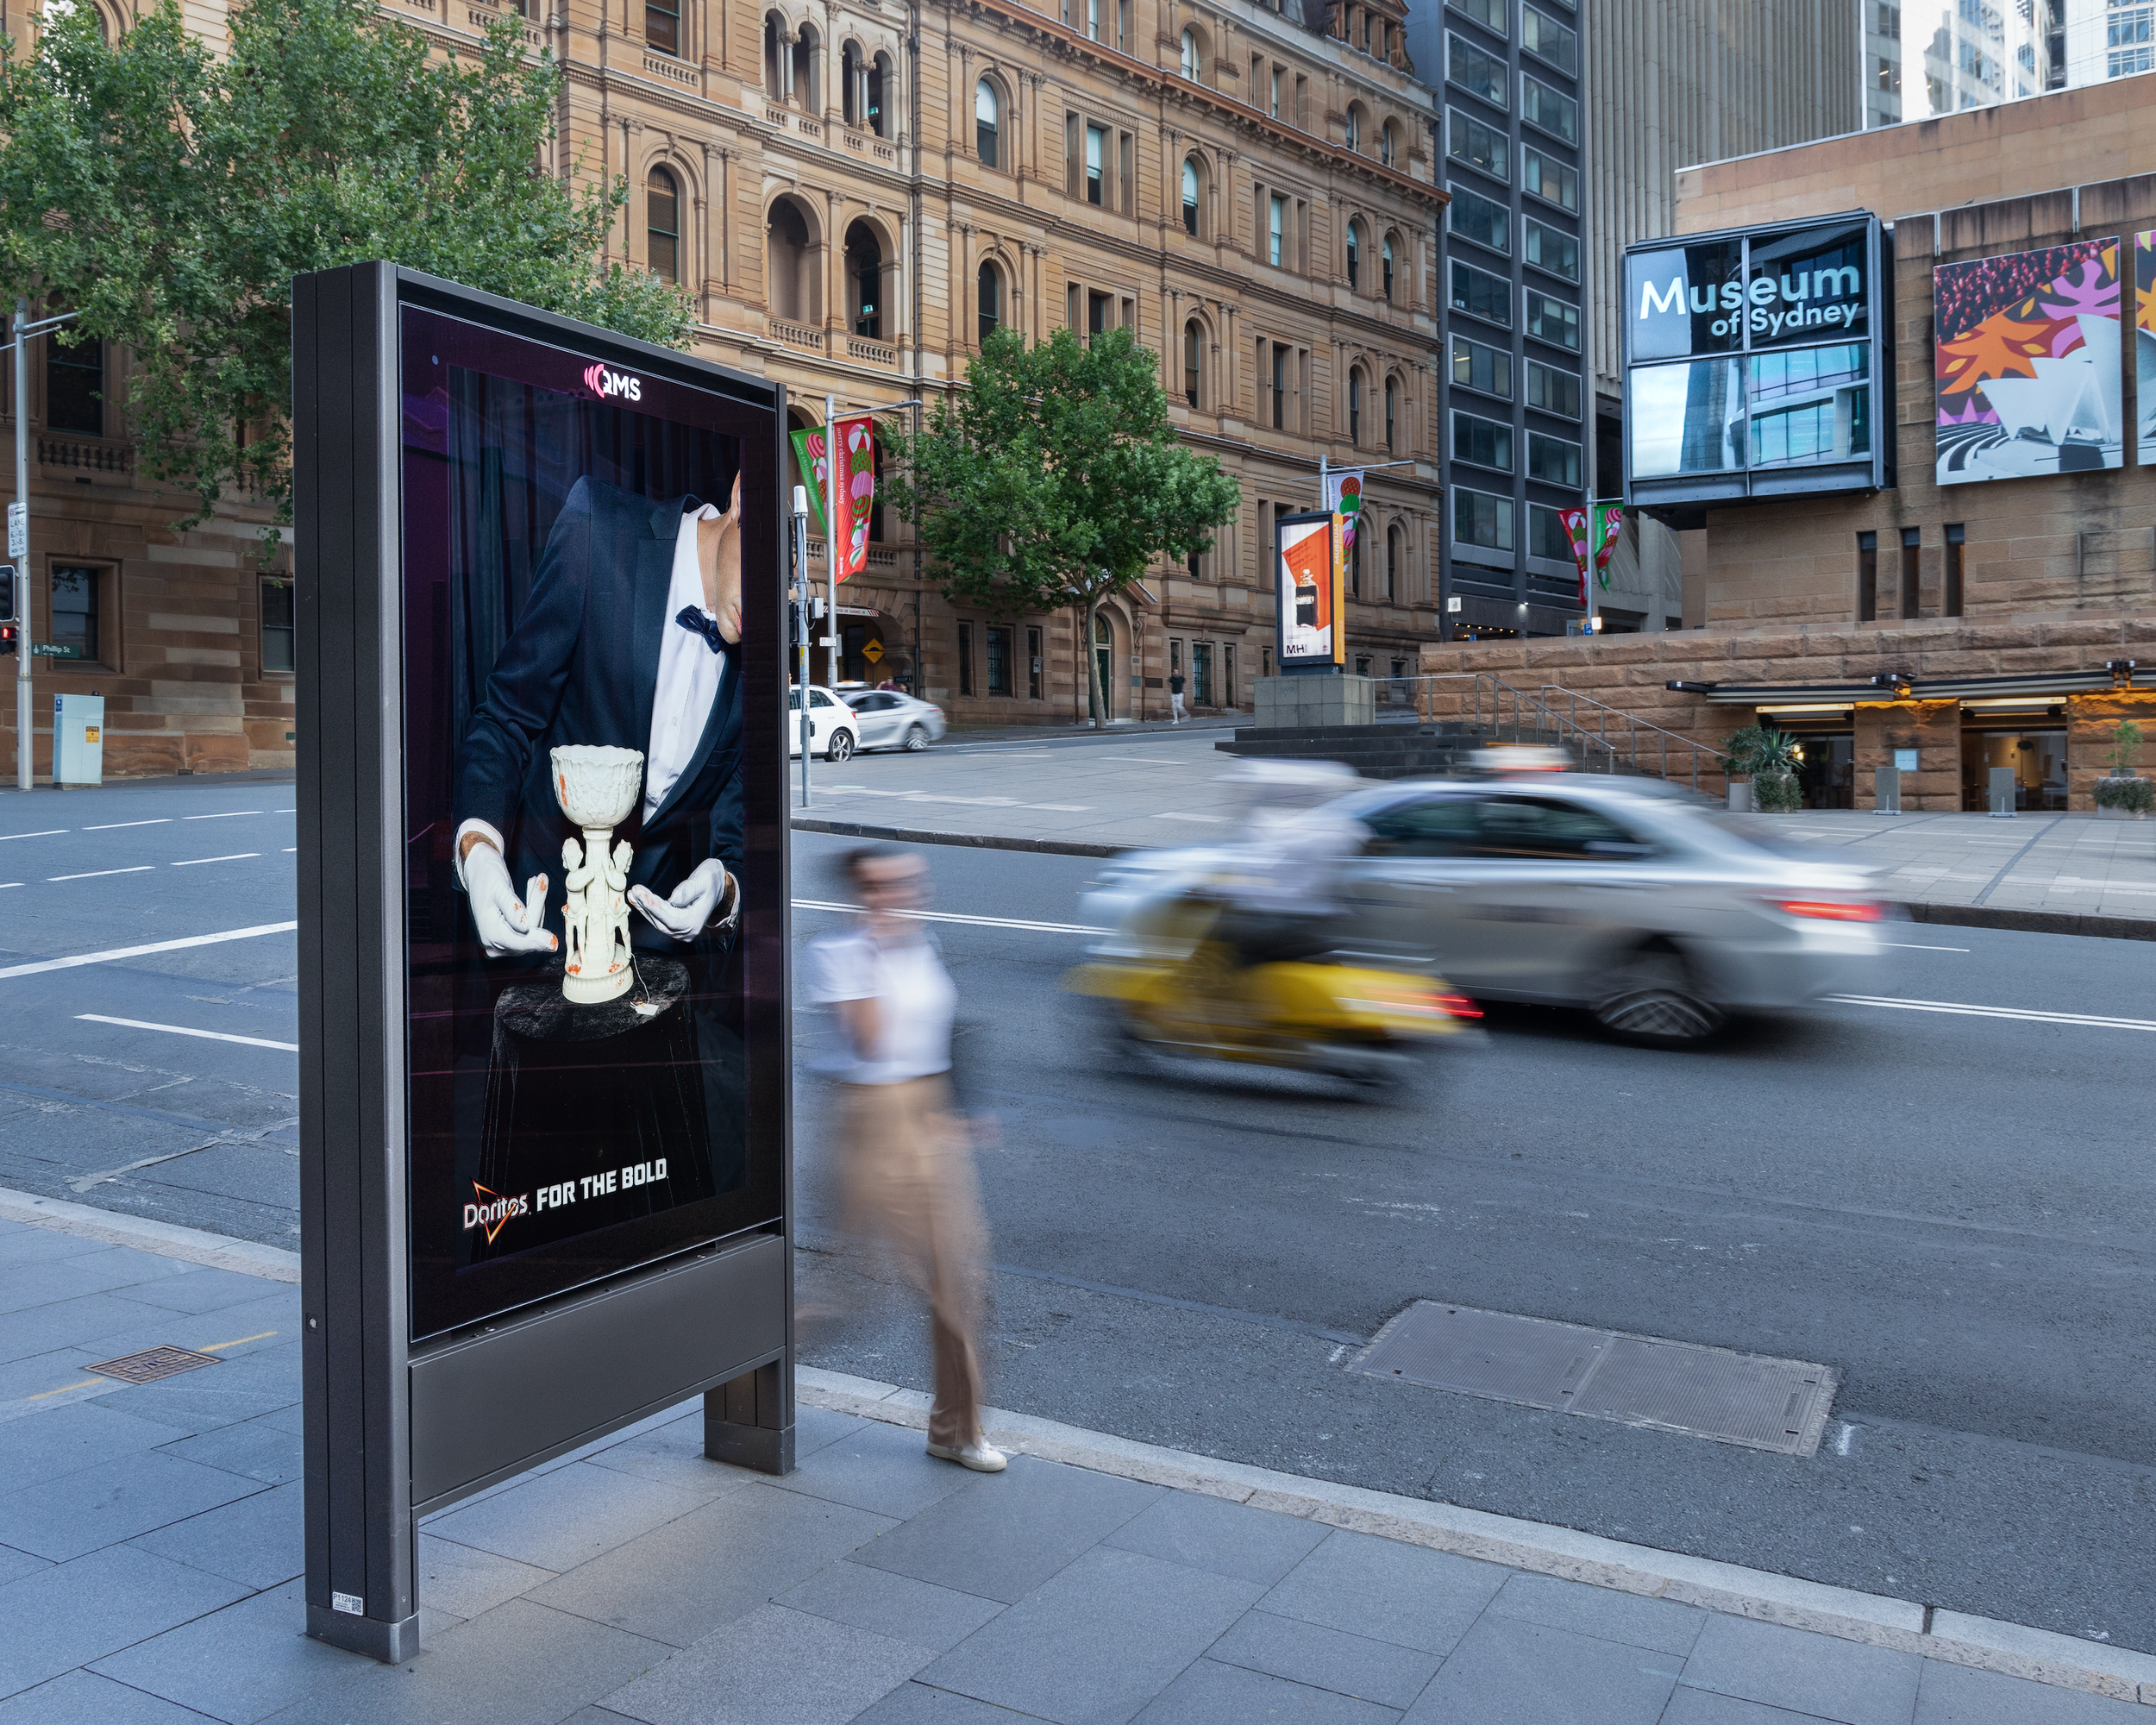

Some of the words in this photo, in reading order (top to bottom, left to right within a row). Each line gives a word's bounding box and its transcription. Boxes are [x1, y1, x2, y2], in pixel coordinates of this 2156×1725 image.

[1639, 266, 1860, 320] Museum
[1711, 310, 1741, 336] of
[1750, 302, 1859, 336] Sydney
[593, 363, 642, 402] QMS
[793, 436, 804, 455] merry
[838, 481, 847, 505] sydney
[63, 645, 71, 654] St
[1286, 644, 1305, 654] MH
[463, 1192, 530, 1230] Doritos
[536, 1180, 576, 1212] FOR
[580, 1169, 617, 1200] THE
[333, 1593, 351, 1603] P1124
